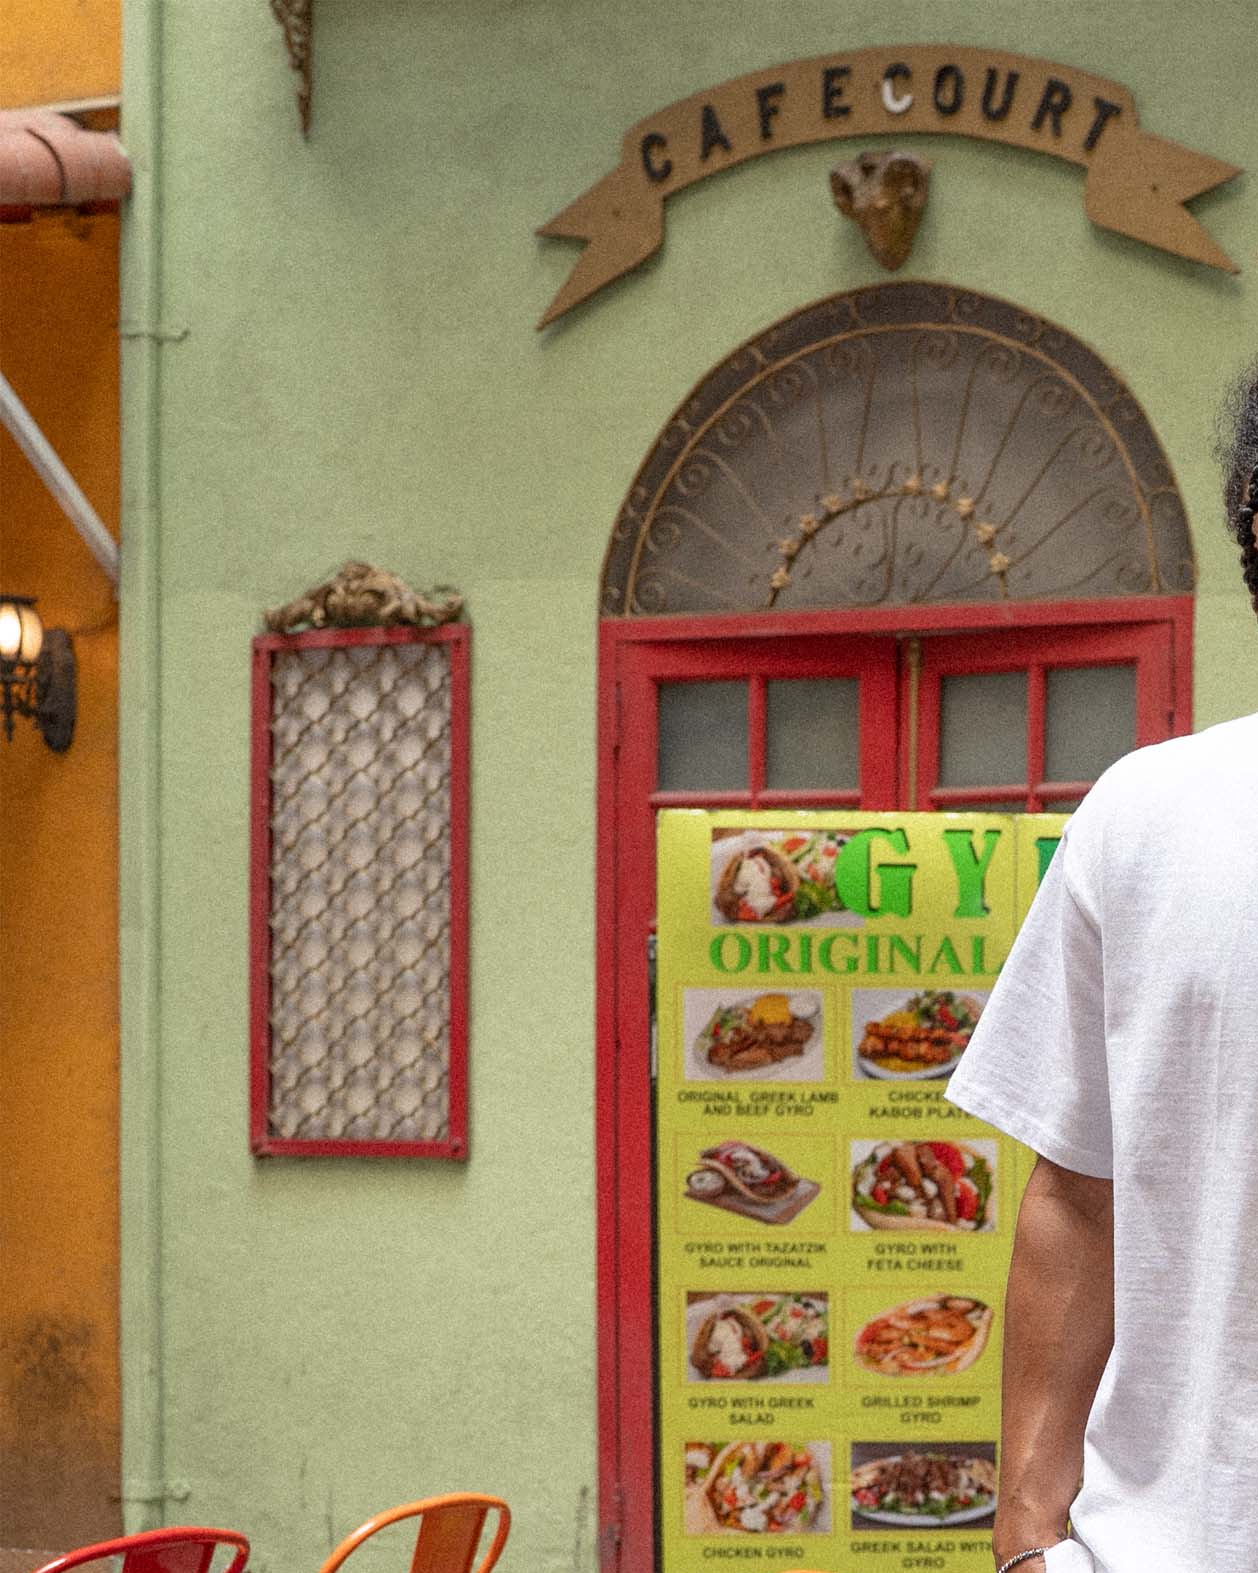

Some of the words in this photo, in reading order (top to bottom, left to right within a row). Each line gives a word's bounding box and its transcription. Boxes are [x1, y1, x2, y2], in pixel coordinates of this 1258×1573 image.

[639, 65, 853, 184] CAFE
[880, 61, 1122, 154] COURT
[708, 931, 1005, 976] ORIGINAL
[678, 1090, 740, 1103] ORIGINAL
[749, 1091, 796, 1104] GREEK
[801, 1091, 840, 1104] LAMB
[888, 1091, 944, 1101] CHICKE
[704, 1104, 732, 1116] AND
[736, 1104, 769, 1116] BEEF
[775, 1104, 815, 1117] GYRO
[869, 1107, 923, 1119] KABOB
[684, 1242, 724, 1254] GYRO
[727, 1242, 761, 1254] WITH
[875, 1243, 917, 1255] GYRO
[921, 1243, 958, 1255] WITH
[699, 1257, 744, 1269] SAUCE
[749, 1257, 812, 1269] ORIGINAL
[867, 1259, 904, 1271] FETA
[906, 1259, 964, 1271] CHEESE
[687, 1397, 727, 1409] GYRO
[730, 1397, 765, 1409] WITH
[768, 1397, 815, 1409] GREEK
[861, 1396, 922, 1409] GRILLED
[926, 1396, 982, 1408] SHRIMP
[729, 1413, 774, 1425] SALAD
[900, 1412, 942, 1424] GYRO
[850, 1541, 900, 1553] GREEK
[906, 1541, 956, 1553] SALAD
[702, 1547, 762, 1560] CHICKEN
[765, 1547, 805, 1559] GYRO
[902, 1556, 946, 1569] GYRO
